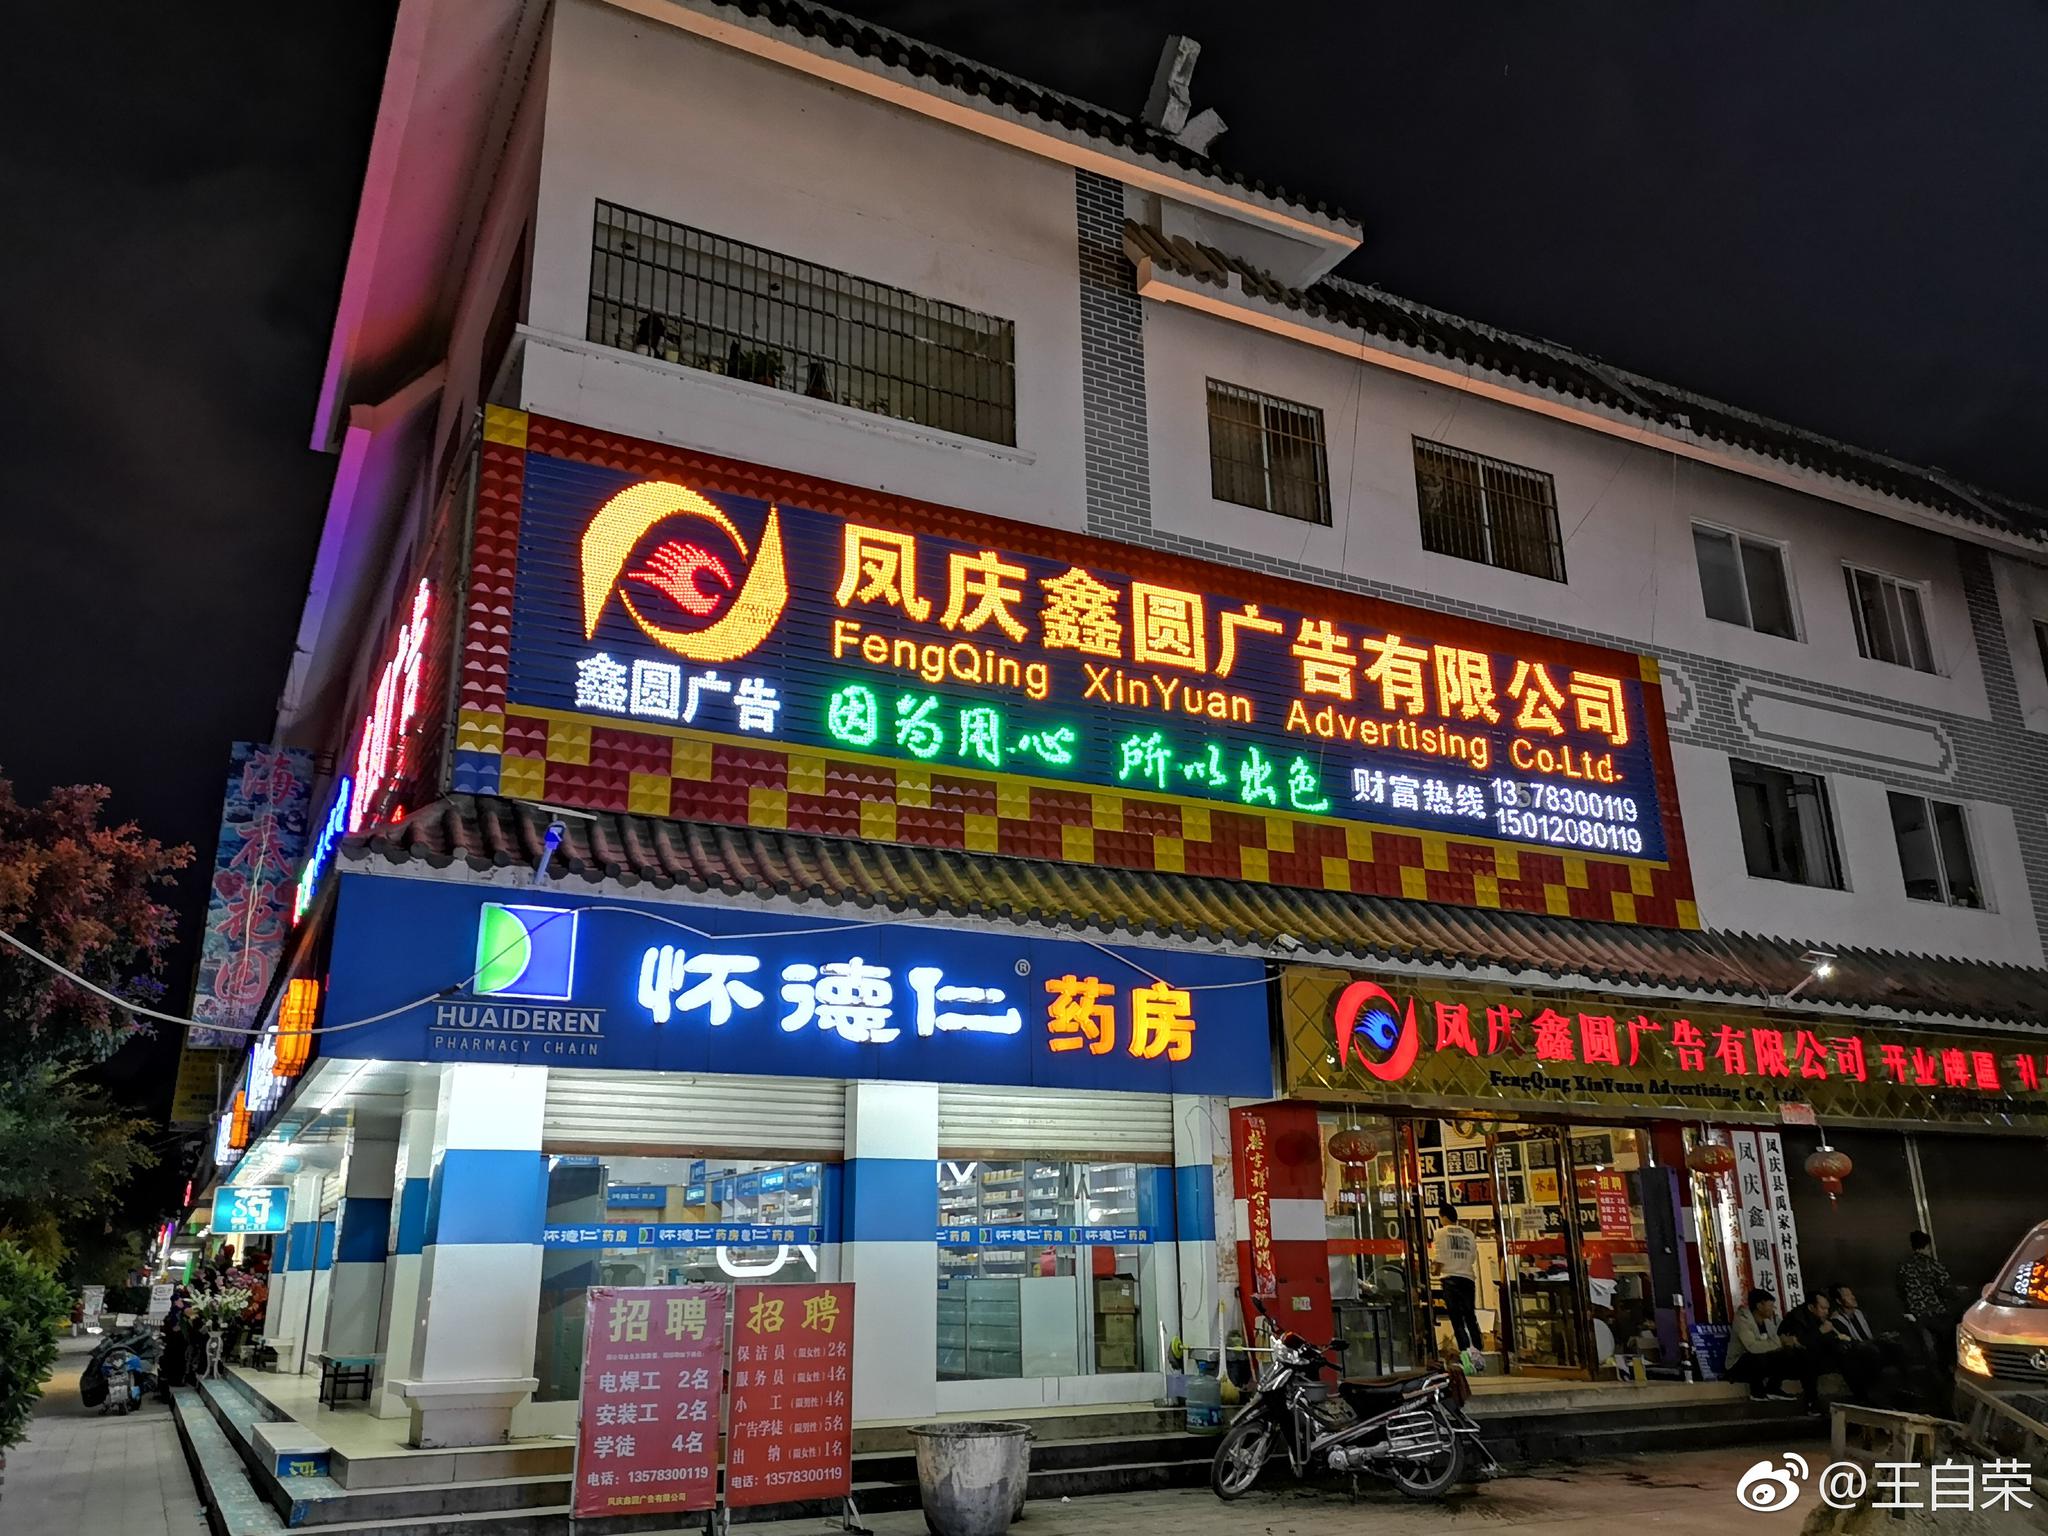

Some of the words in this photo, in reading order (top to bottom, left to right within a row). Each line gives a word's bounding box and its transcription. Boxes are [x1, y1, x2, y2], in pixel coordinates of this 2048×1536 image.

[835, 522, 1630, 748] 凤庆鑫圆广告有限公司
[574, 650, 782, 734] 鑫圆广告
[832, 620, 1050, 701] FengQing
[1083, 662, 1252, 725] XinYuan
[1286, 700, 1489, 771] Advertising
[828, 685, 1076, 767] 因为用心
[1118, 731, 1331, 814] 所以出色
[1351, 767, 1488, 821] 财富热线
[1490, 777, 1639, 823] 13578300119
[1495, 806, 1644, 855] 15012080119
[436, 1005, 600, 1034] HUAIDEREN
[637, 943, 1023, 1044] 怀德仁
[1043, 972, 1197, 1062] 药房
[435, 1036, 530, 1053] PHARMACY
[543, 1041, 598, 1056] CHAIN
[1434, 1000, 1869, 1083] 凤庆鑫圆广告有限公司
[1489, 1070, 1572, 1092] FengQing
[1572, 1075, 1644, 1094] XinYuan
[1648, 1078, 1741, 1102] Advertising
[1880, 1043, 2002, 1090] 开业牌匾
[2015, 1053, 2048, 1090] 礼
[608, 1297, 707, 1343] 招聘
[745, 1289, 841, 1335] 招聘
[599, 1370, 661, 1393] 电焊工
[677, 1367, 709, 1390] 2名
[595, 1402, 659, 1426] 安装工
[676, 1399, 708, 1422] 2名
[593, 1434, 636, 1459] 学徒
[671, 1431, 704, 1454] 4名
